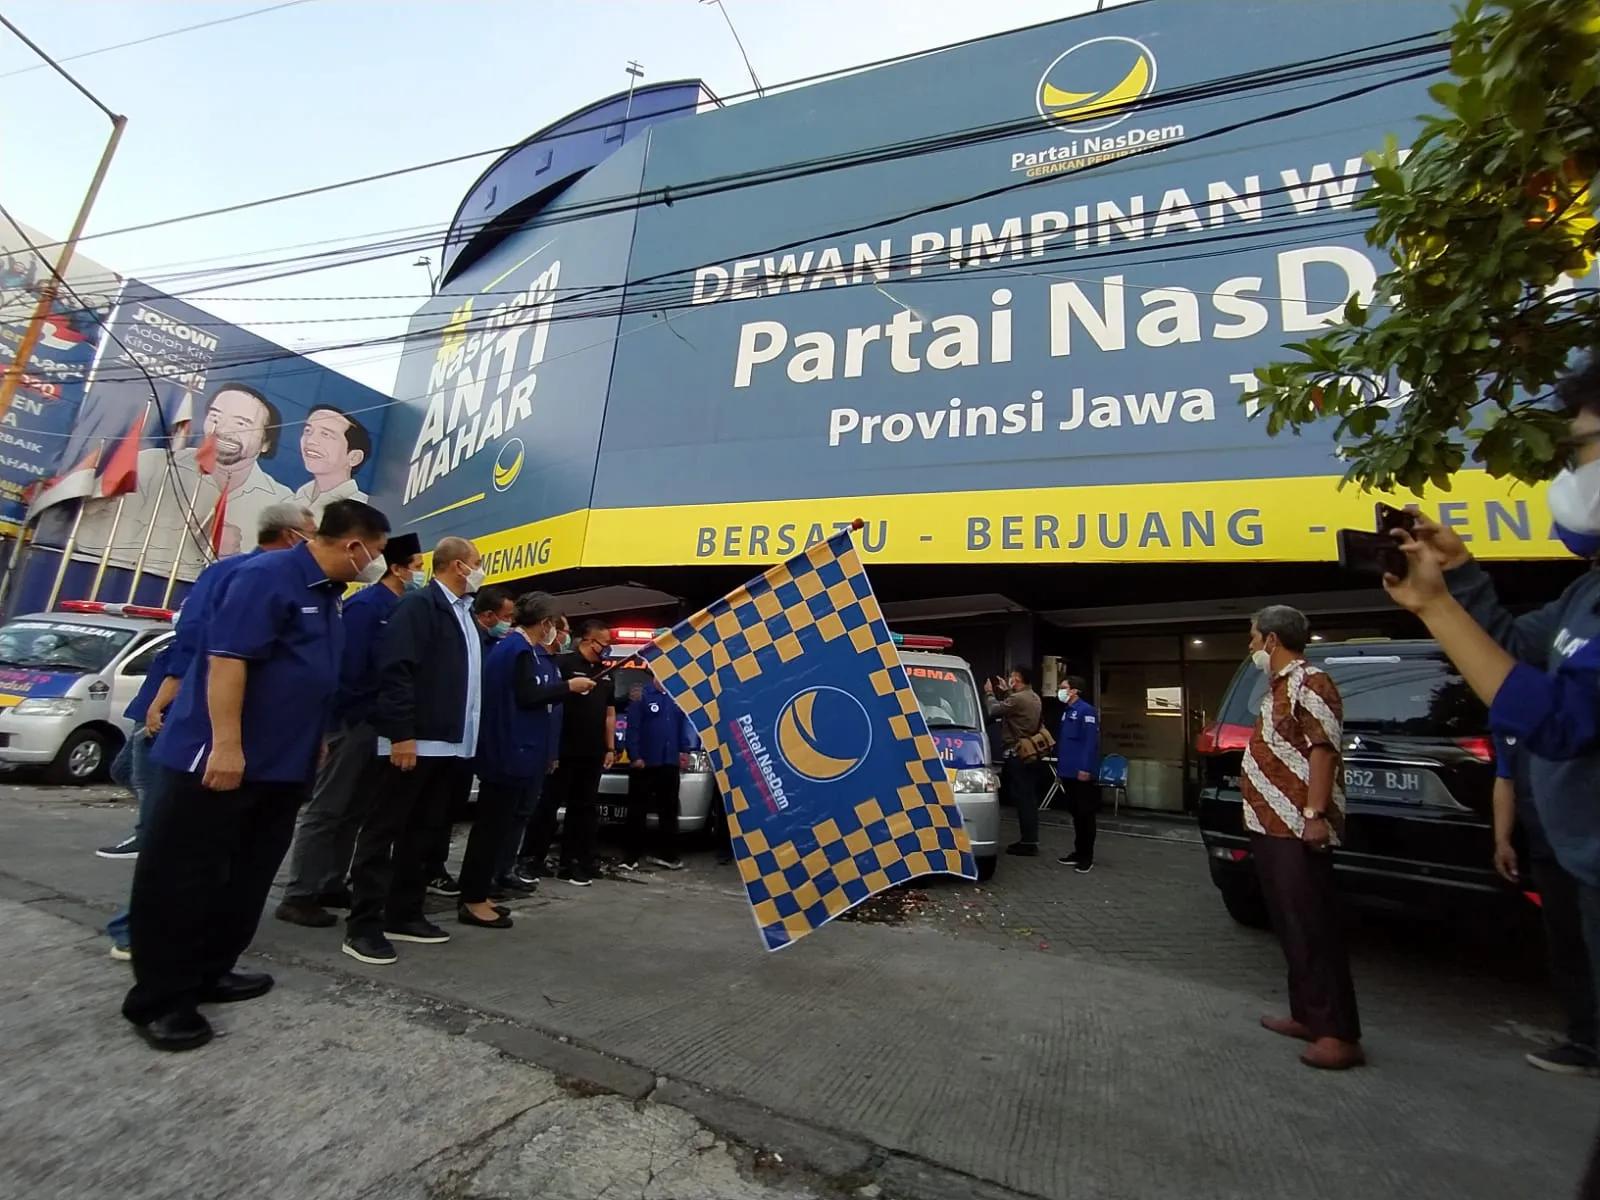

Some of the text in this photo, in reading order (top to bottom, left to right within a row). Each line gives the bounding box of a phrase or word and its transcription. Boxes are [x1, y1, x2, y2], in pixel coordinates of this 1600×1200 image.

[1011, 124, 1185, 169] Partai NasDem
[1026, 158, 1085, 178] GERAKAN
[691, 239, 893, 305] DEWAN
[910, 175, 1262, 276] PIMPINAN
[124, 333, 153, 353] Kita
[128, 323, 184, 352] Adalah
[132, 307, 218, 352] JOKOWI
[734, 288, 1014, 389] Partai
[410, 293, 556, 463] ANTI
[829, 390, 1044, 447] Provinsi
[1060, 379, 1216, 432] Jawa
[402, 373, 537, 506] MAHAR
[696, 520, 888, 557] BERSAU
[966, 508, 1265, 552] BERJUANG
[738, 713, 767, 755] Partai
[757, 754, 790, 810] NasDem
[1385, 772, 1420, 790] BJH
